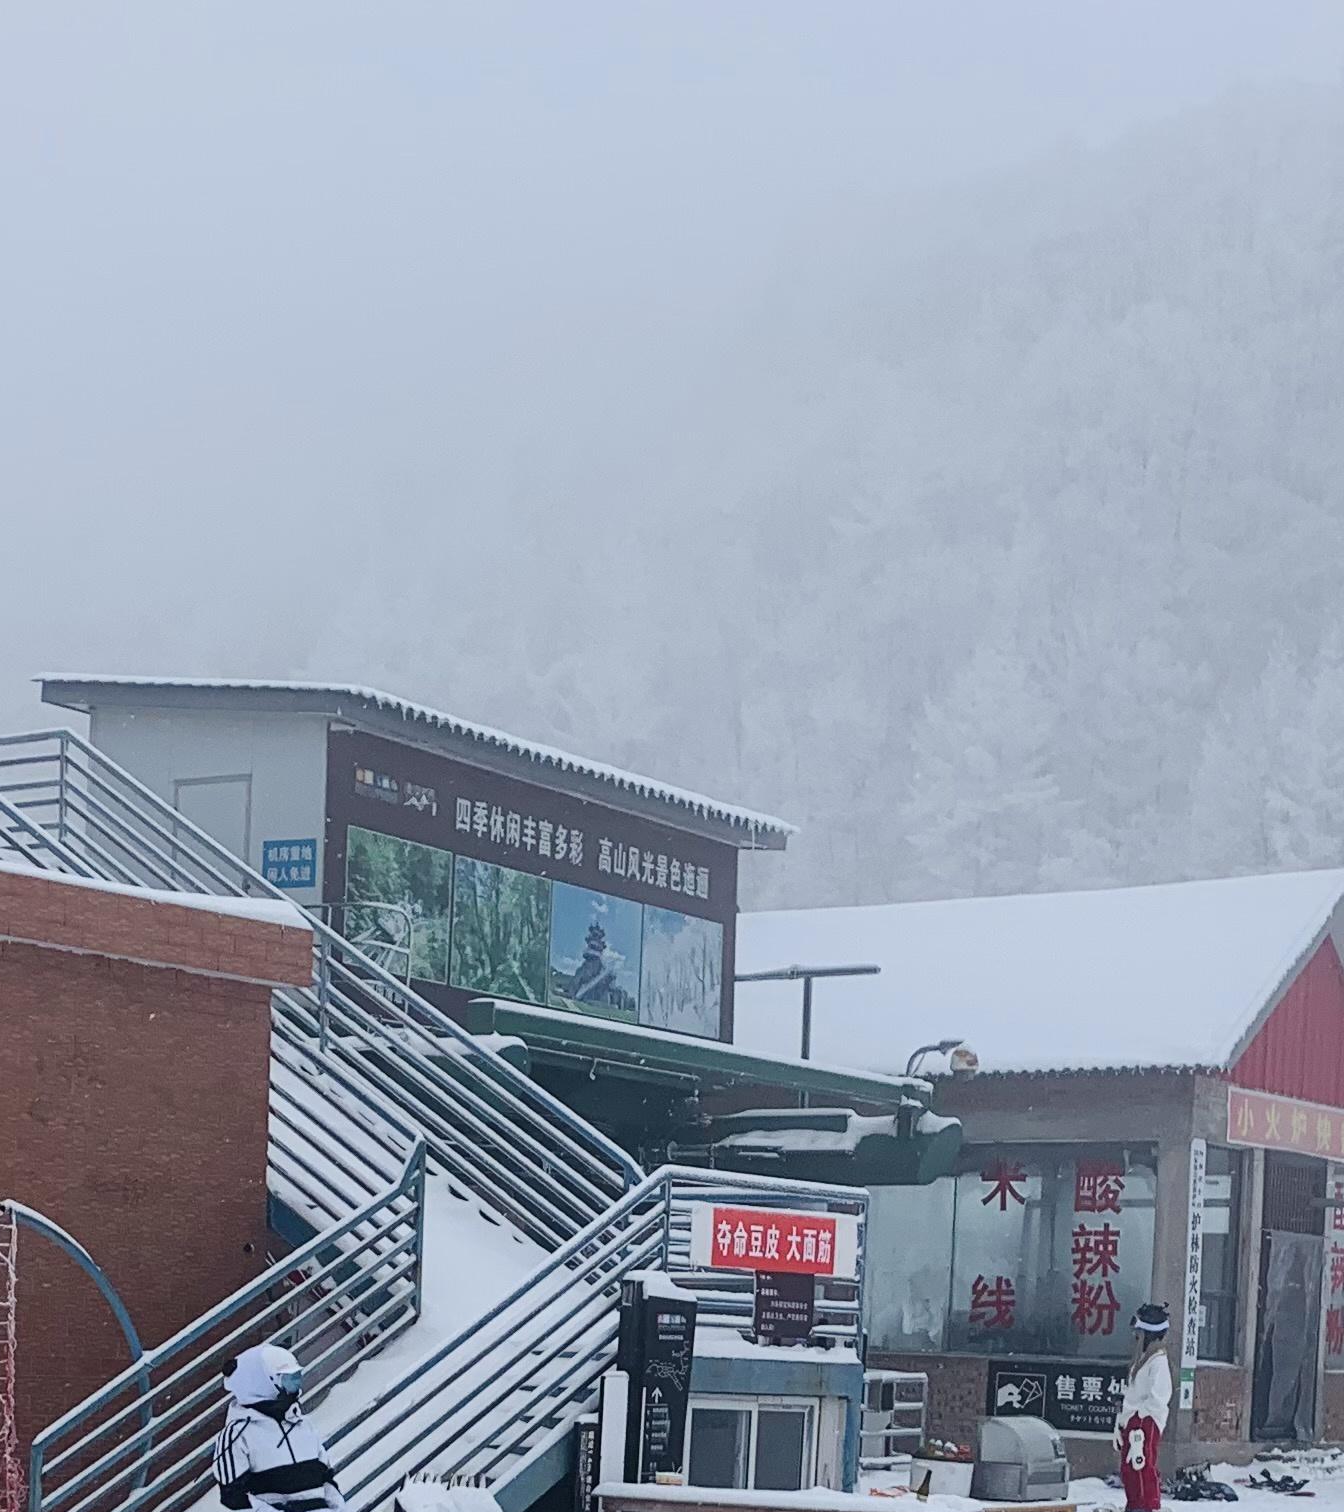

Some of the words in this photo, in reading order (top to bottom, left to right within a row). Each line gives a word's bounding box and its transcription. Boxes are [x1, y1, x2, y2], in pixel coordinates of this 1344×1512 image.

[455, 797, 584, 866] 四季休闲丰富多彩
[717, 1219, 780, 1261] 夺命豆皮
[786, 1226, 832, 1265] 大面筋
[1071, 1157, 1125, 1336] 酸辣粉
